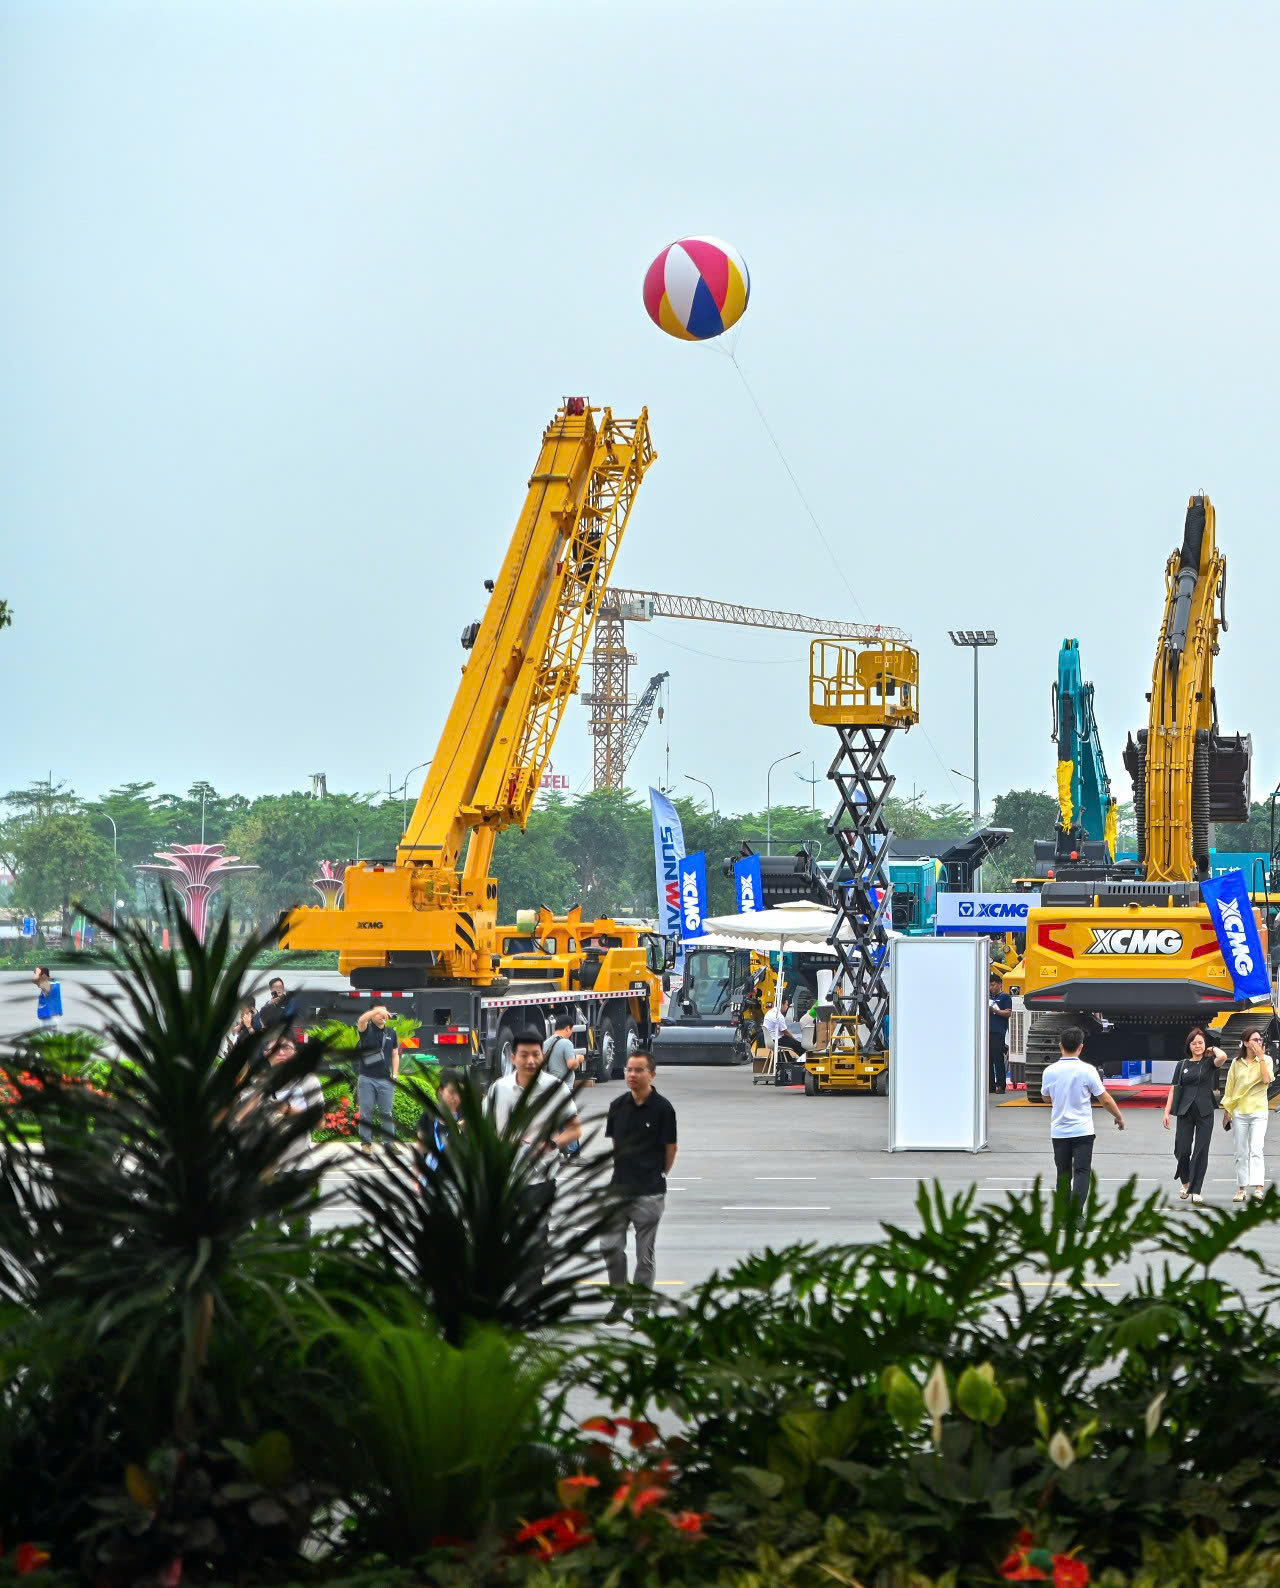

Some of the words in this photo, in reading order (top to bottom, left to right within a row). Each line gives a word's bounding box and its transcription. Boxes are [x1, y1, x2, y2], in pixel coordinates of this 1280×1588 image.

[539, 775, 569, 788] TEL
[682, 871, 701, 931] XCMG
[740, 874, 756, 913] XCM
[974, 903, 1030, 918] XCMG
[1085, 928, 1184, 955] XCMG
[1216, 897, 1254, 977] XCMG
